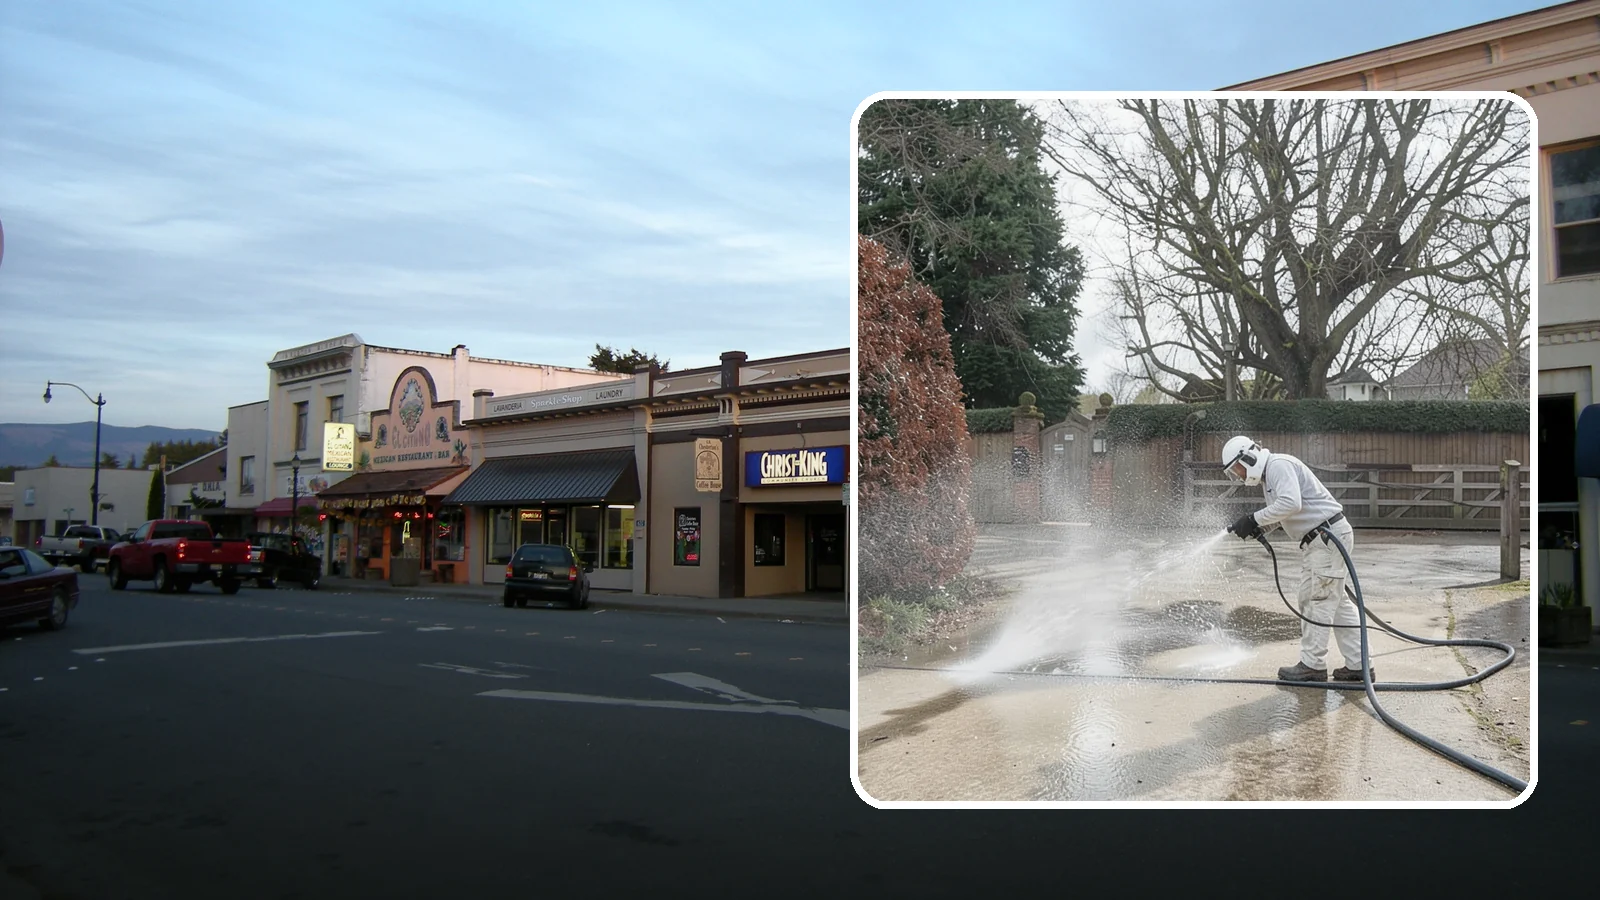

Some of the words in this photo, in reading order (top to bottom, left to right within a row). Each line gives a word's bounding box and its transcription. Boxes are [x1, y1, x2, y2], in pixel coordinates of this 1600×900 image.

[595, 389, 623, 400] LAUNDRY
[493, 402, 523, 412] LAVANDERIA
[530, 395, 561, 409] Sparkle
[562, 394, 582, 405] Shop
[373, 455, 396, 464] MEXICAN
[397, 452, 433, 463] RESTAURANT
[438, 450, 450, 459] BAR
[760, 452, 798, 478] CHRIST
[799, 450, 828, 476] KING
[697, 480, 709, 488] Coffee
